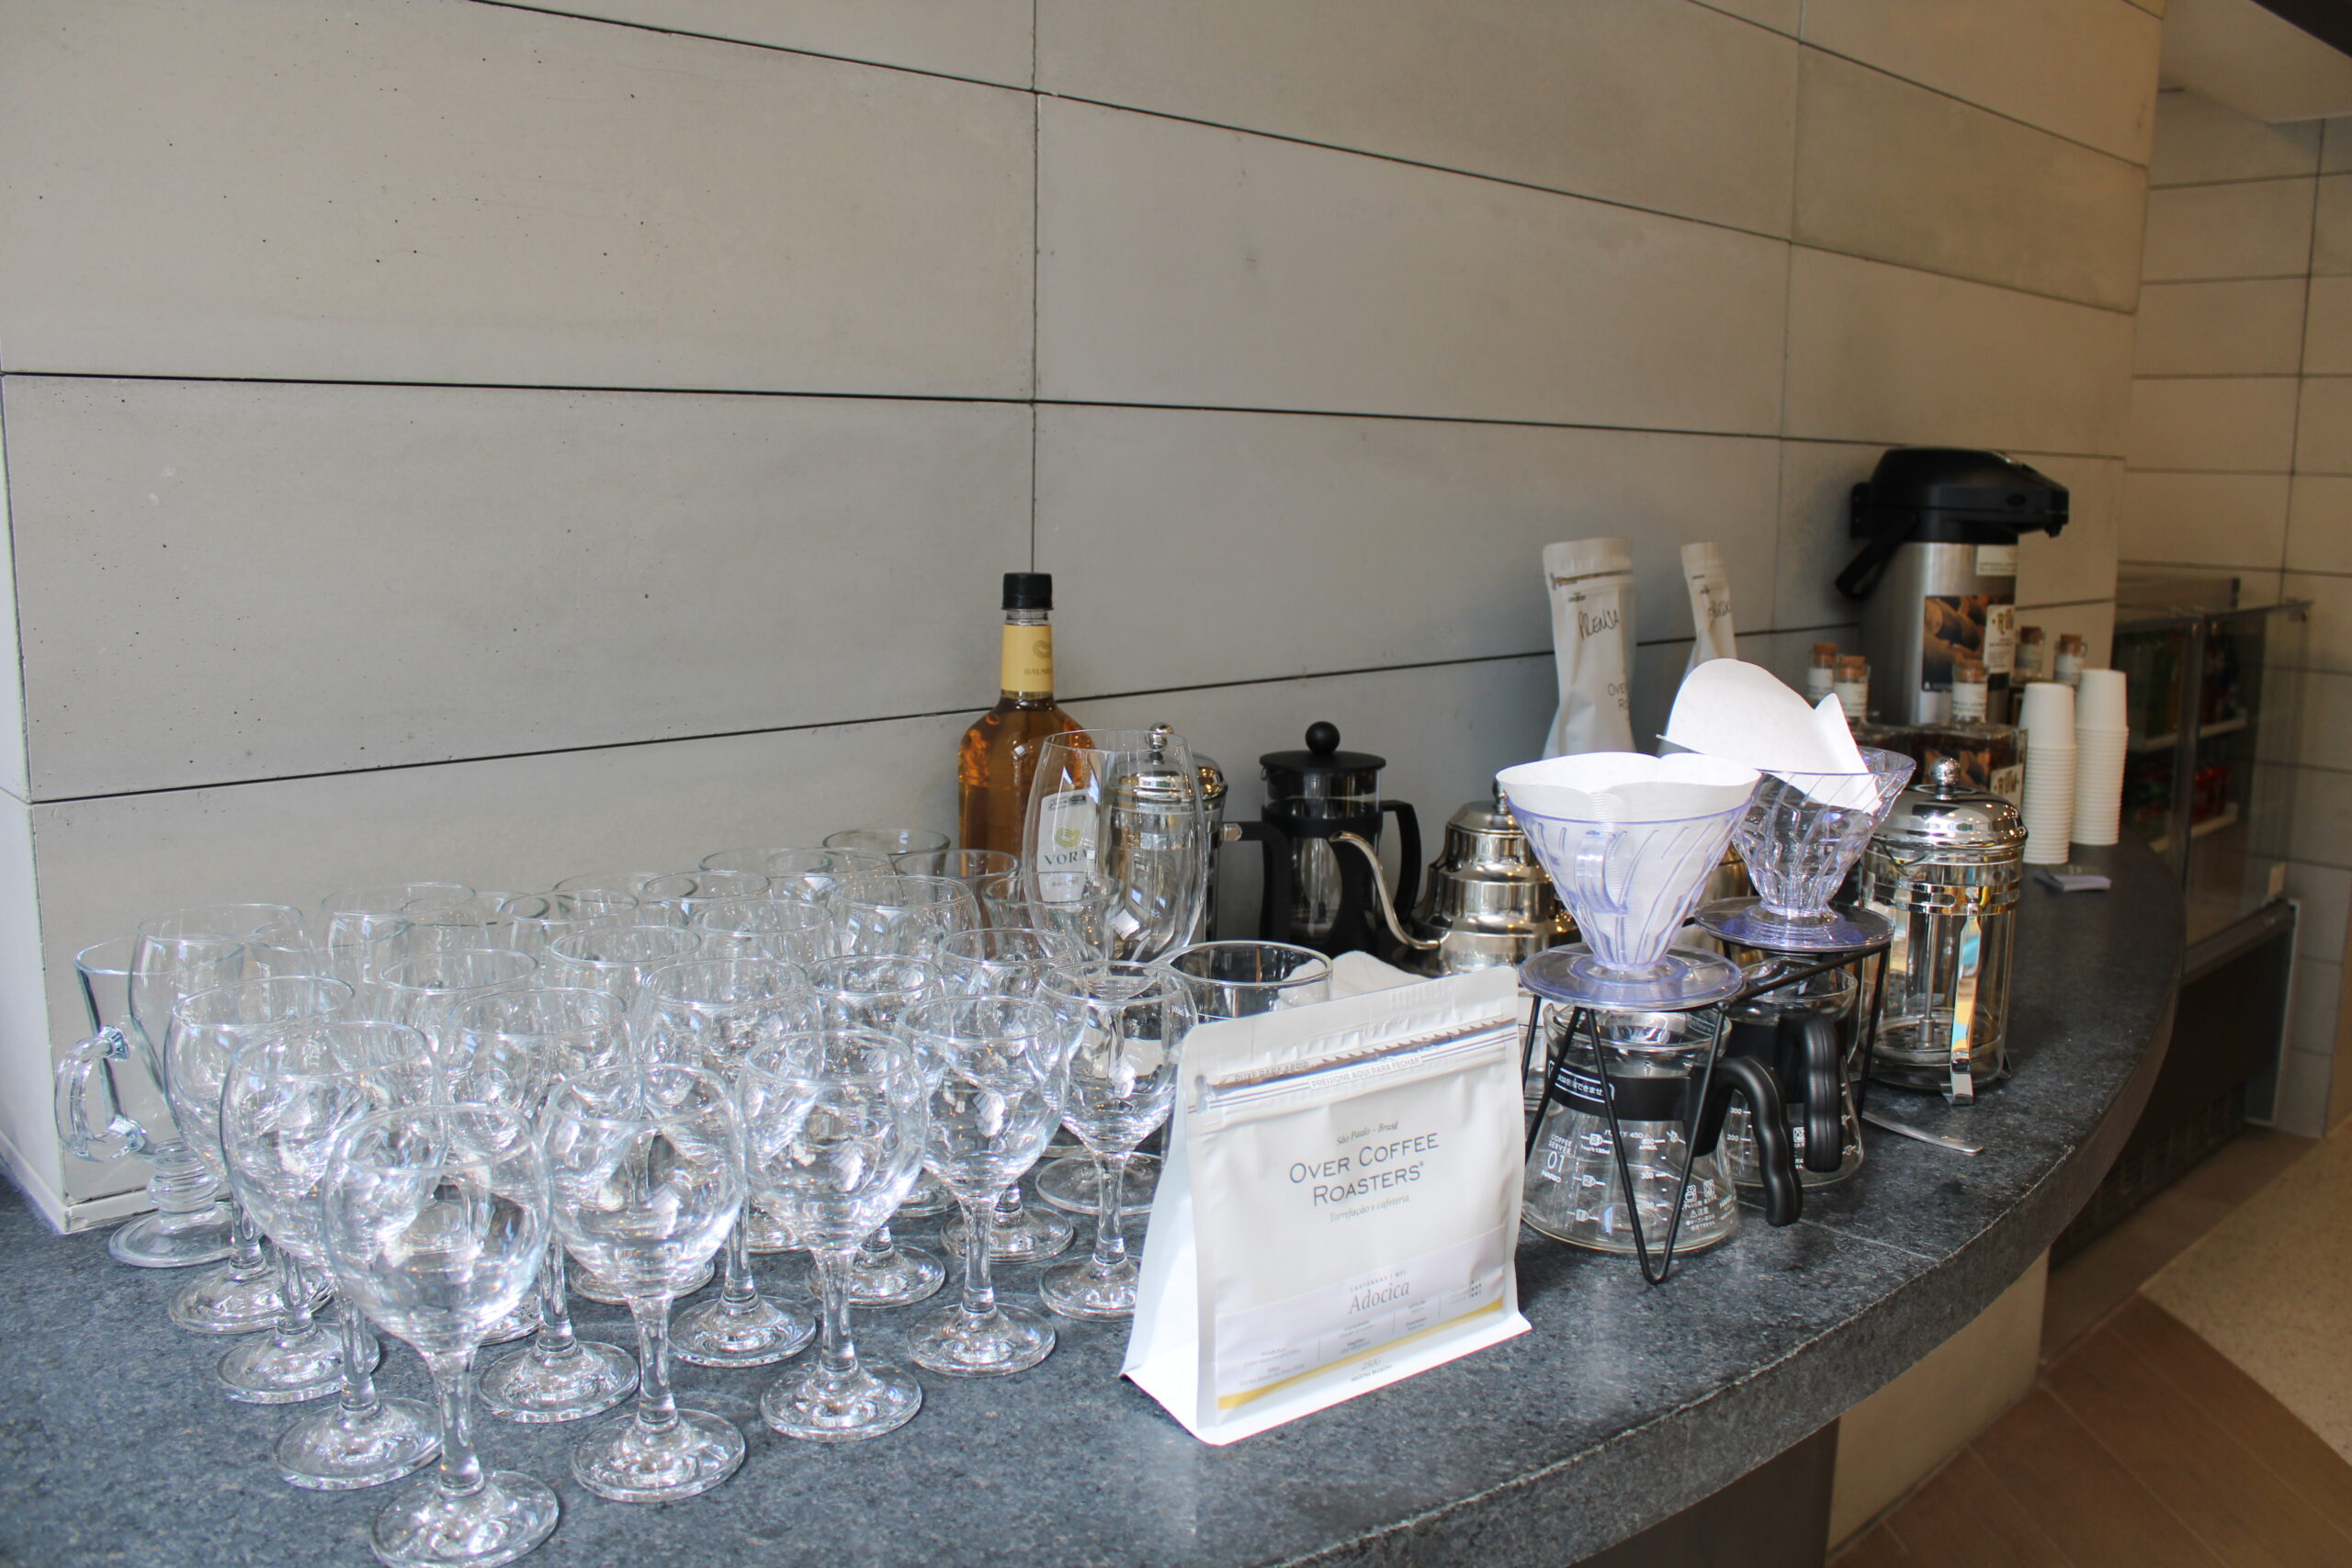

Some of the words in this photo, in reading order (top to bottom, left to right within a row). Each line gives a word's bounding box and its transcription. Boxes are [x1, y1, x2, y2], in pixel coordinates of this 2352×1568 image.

[1311, 1073, 1351, 1089] PRESSIONE
[1372, 1064, 1392, 1076] PARA
[1393, 1057, 1421, 1071] FECHAR
[1729, 1107, 1742, 1115] 300
[1337, 1135, 1351, 1146] São
[1350, 1126, 1372, 1143] Paulo
[1378, 1121, 1398, 1134] Brasil
[1551, 1134, 1573, 1147] COFFEE
[1726, 1134, 1739, 1142] 200
[1289, 1156, 1351, 1183] OVER
[1359, 1133, 1440, 1167] COFFEE
[1548, 1140, 1572, 1155] SERVER
[1547, 1151, 1565, 1173] 01
[1329, 1204, 1371, 1223] Torrefação
[1377, 1195, 1410, 1214] cafeteria
[1348, 1281, 1410, 1314] Adocica
